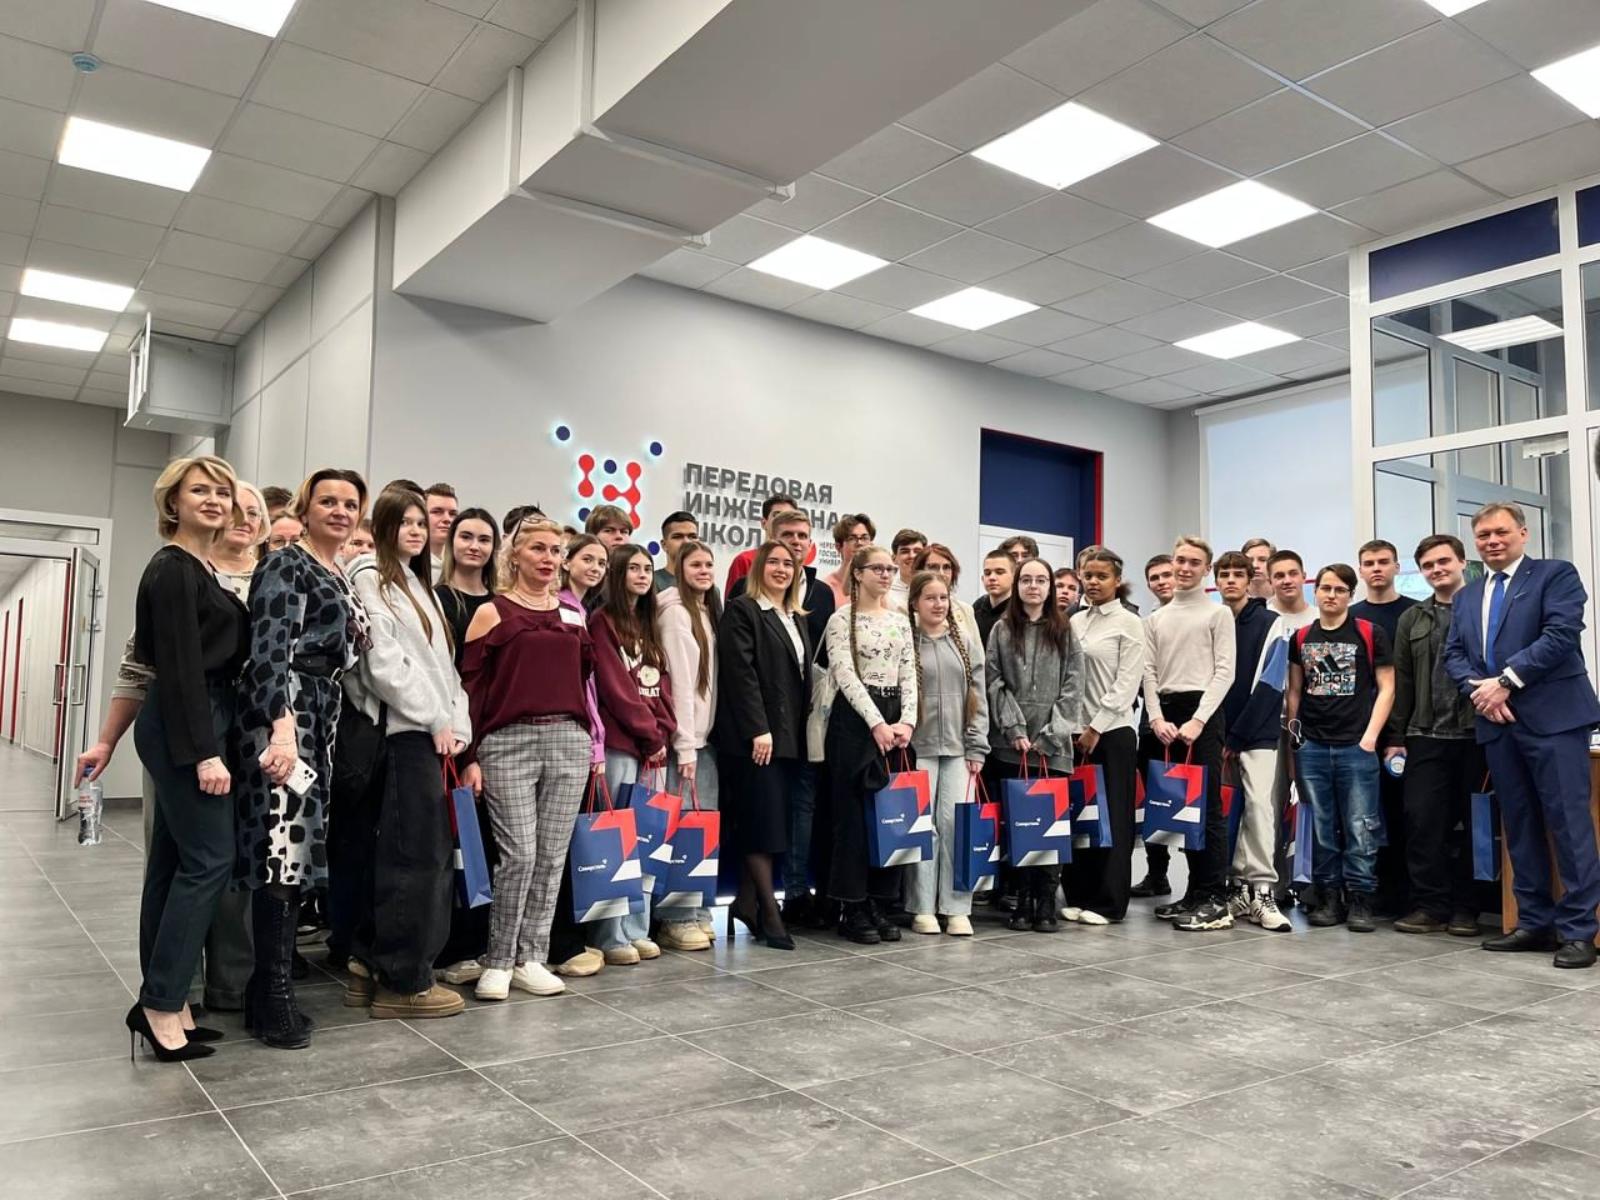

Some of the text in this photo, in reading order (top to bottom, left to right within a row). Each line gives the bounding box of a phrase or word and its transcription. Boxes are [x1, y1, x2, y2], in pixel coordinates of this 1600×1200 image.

[684, 462, 833, 504] ПЕРЕДОВАЯ
[684, 491, 848, 530] ИНЖЕНА
[698, 520, 762, 548] КОЛ
